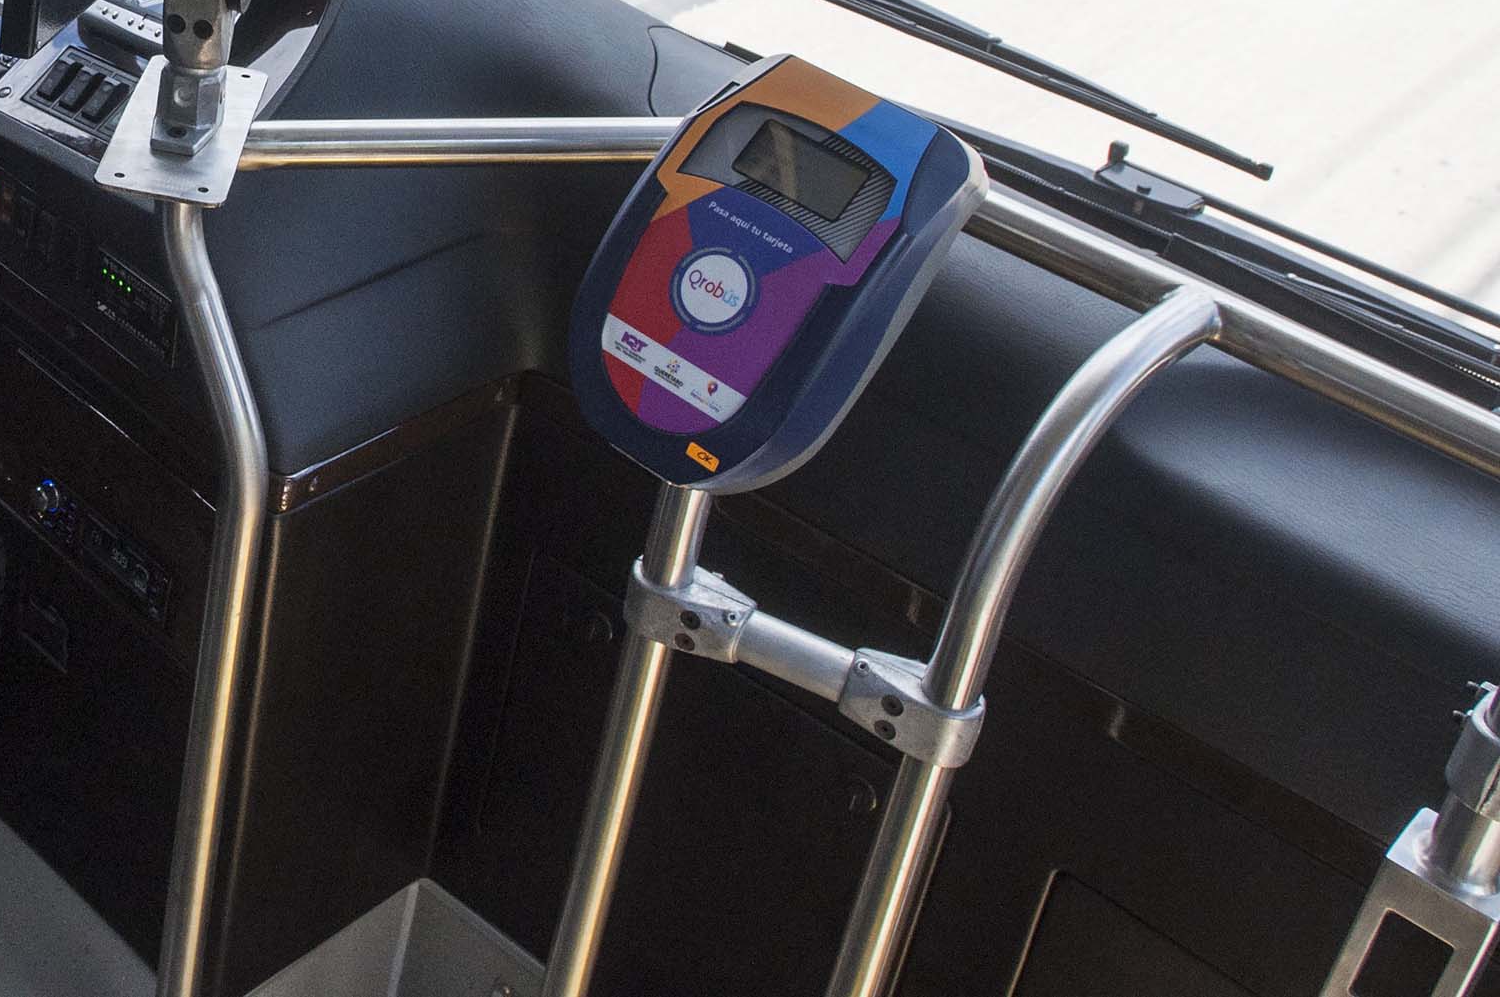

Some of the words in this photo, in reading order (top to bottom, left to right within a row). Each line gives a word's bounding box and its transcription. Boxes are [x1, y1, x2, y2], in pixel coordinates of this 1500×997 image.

[708, 200, 729, 219] Pasa
[730, 215, 751, 228] aquí
[751, 225, 762, 237] tu
[763, 232, 793, 254] tarjeta
